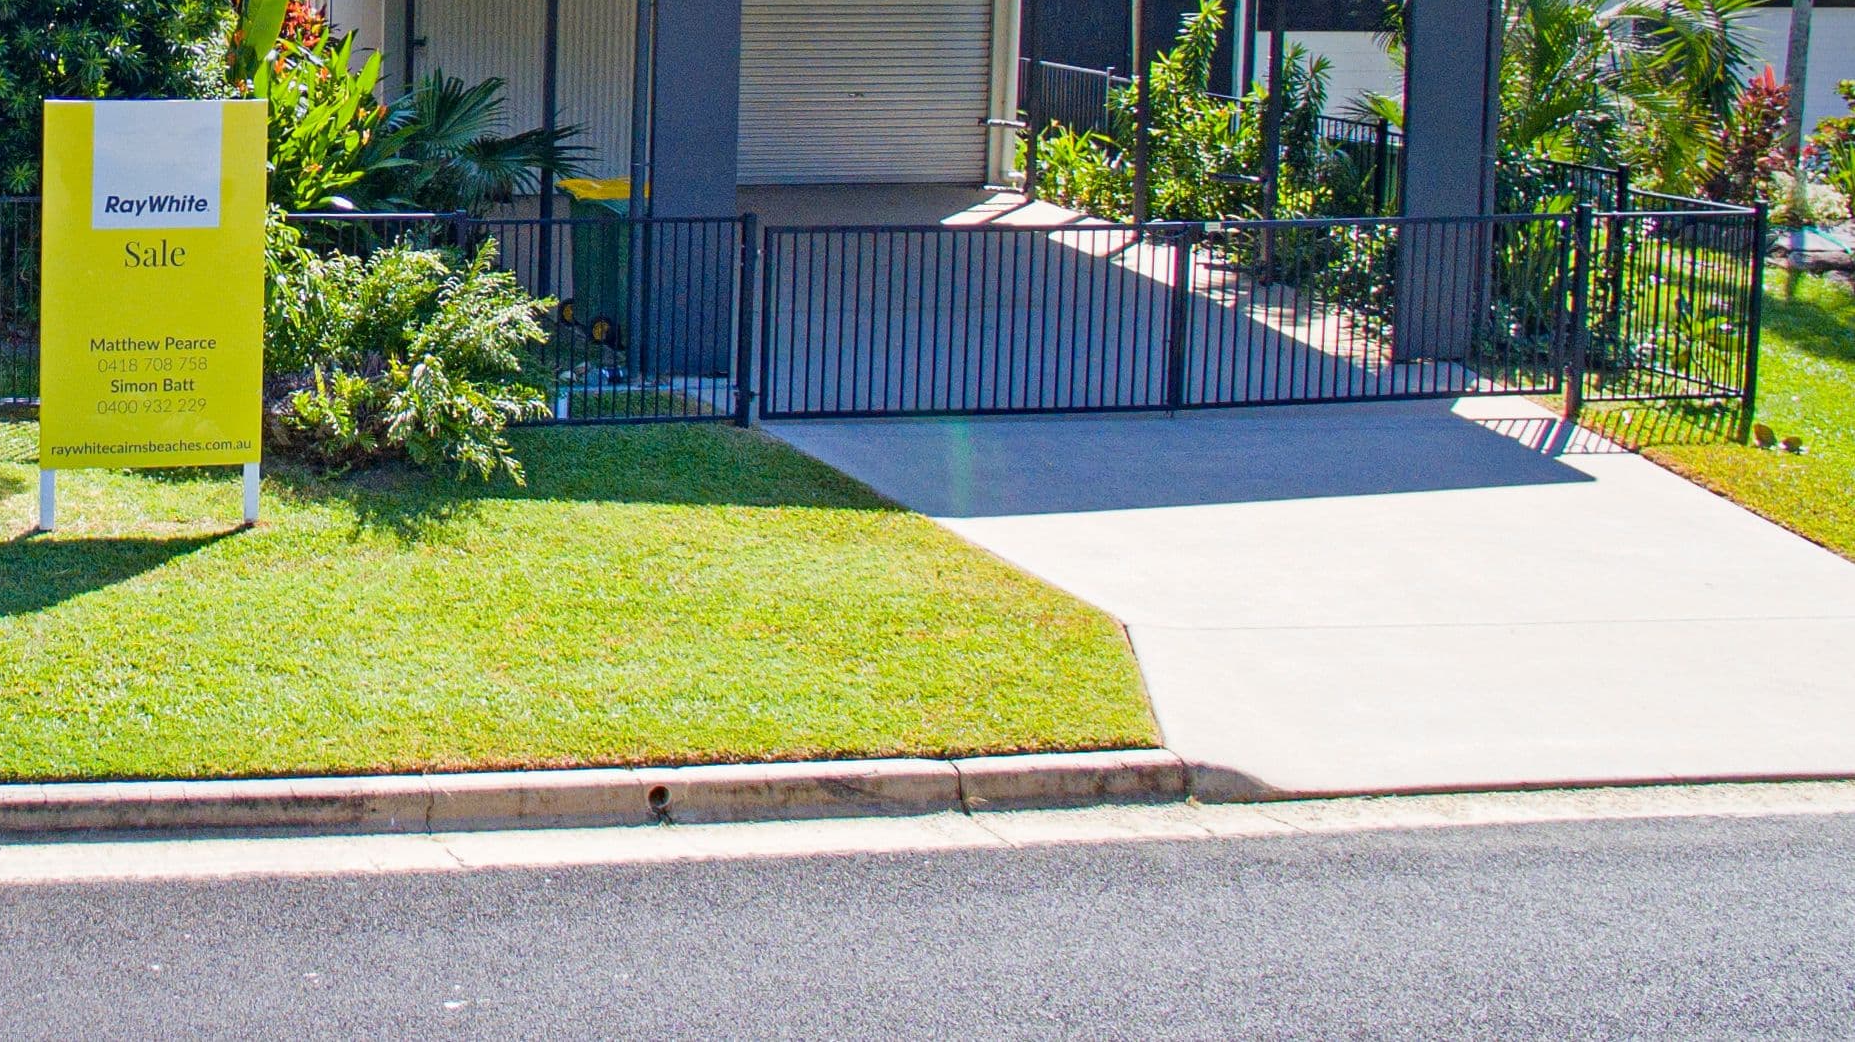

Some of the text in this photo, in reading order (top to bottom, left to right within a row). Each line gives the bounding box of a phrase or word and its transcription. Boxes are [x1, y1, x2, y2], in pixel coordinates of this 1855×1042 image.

[124, 239, 185, 268] Sale
[90, 337, 217, 352] Matthew Pearce
[97, 356, 208, 372] 0418 708 758
[110, 378, 195, 393] Simon Batt
[97, 398, 207, 414] 0400 932 229
[51, 439, 251, 457] raywhitecairnsbeaches.com.au
